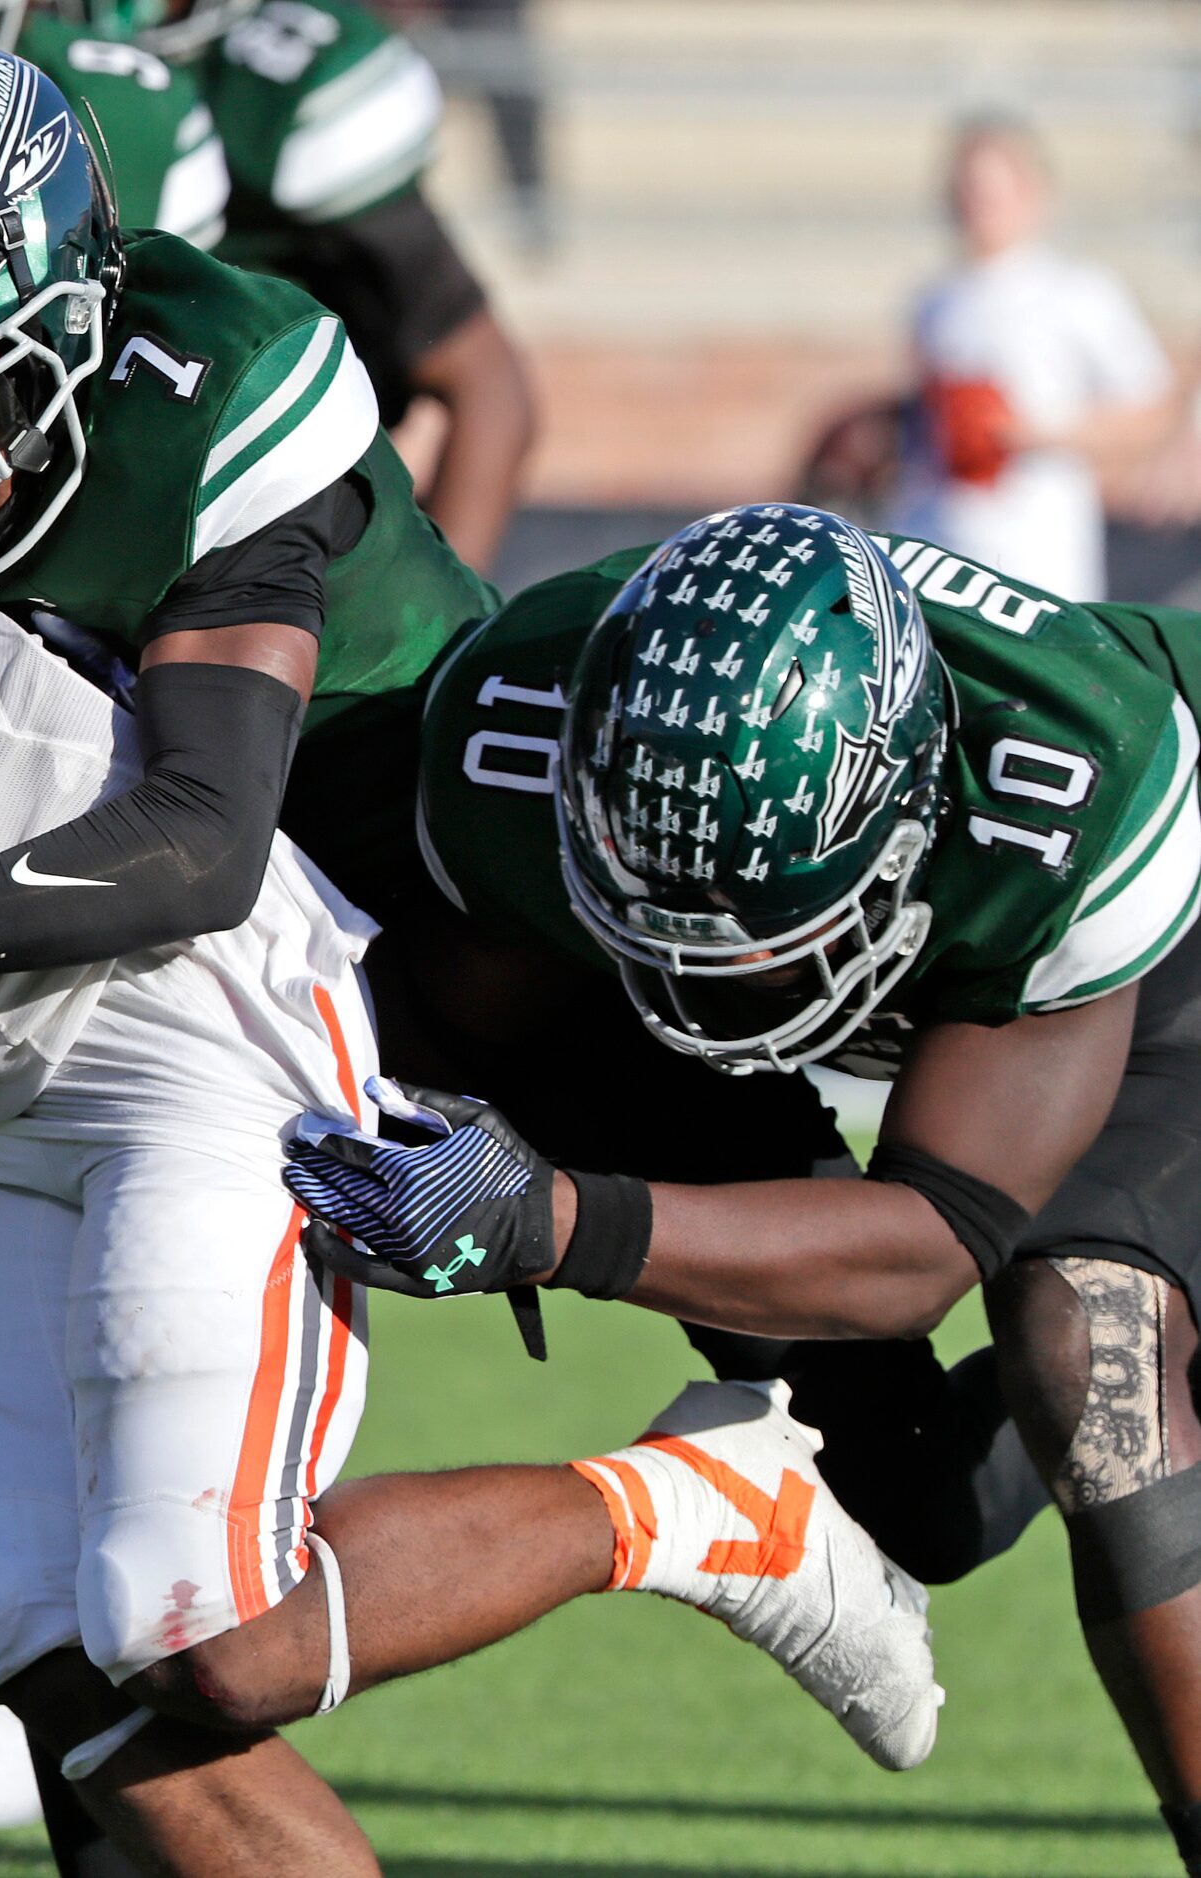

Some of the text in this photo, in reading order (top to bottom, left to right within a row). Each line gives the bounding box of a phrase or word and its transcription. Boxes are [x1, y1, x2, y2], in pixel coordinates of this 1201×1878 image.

[107, 333, 209, 401] 7
[829, 531, 877, 632] INDIANS
[462, 674, 569, 794] 10
[966, 734, 1098, 871] 10
